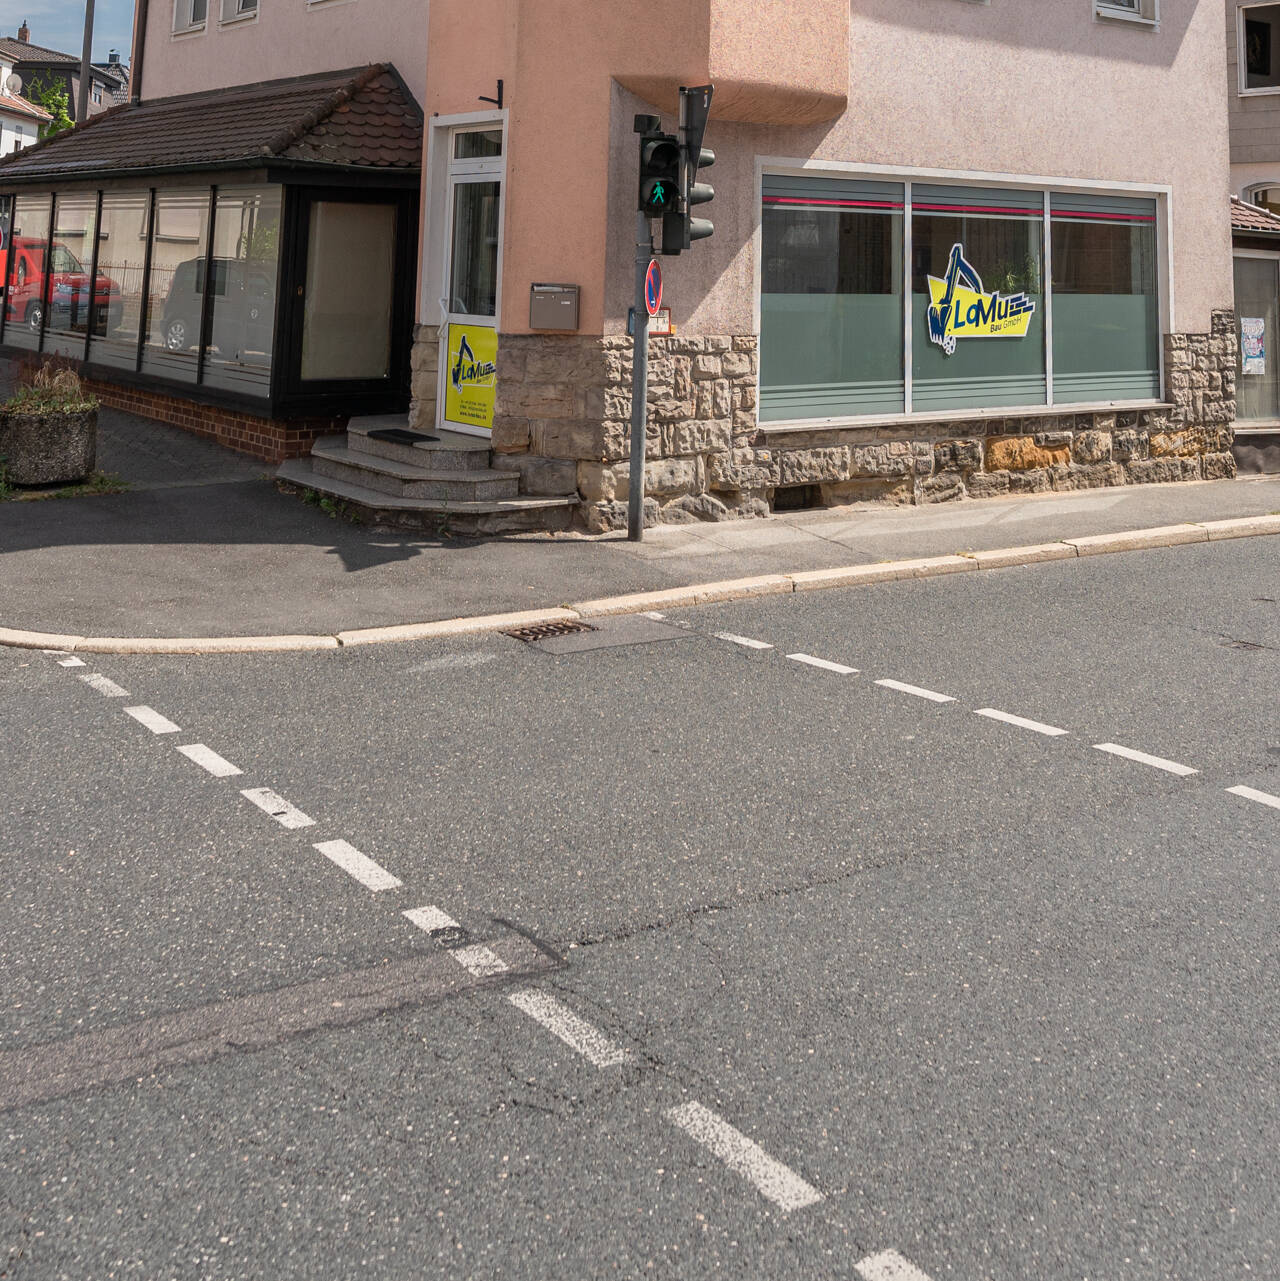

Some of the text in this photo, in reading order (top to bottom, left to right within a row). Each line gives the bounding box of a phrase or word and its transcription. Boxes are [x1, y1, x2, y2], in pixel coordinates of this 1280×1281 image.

[954, 293, 1009, 329] LaMu
[990, 316, 1022, 333] Bau GmbH
[461, 362, 486, 380] LaMu
